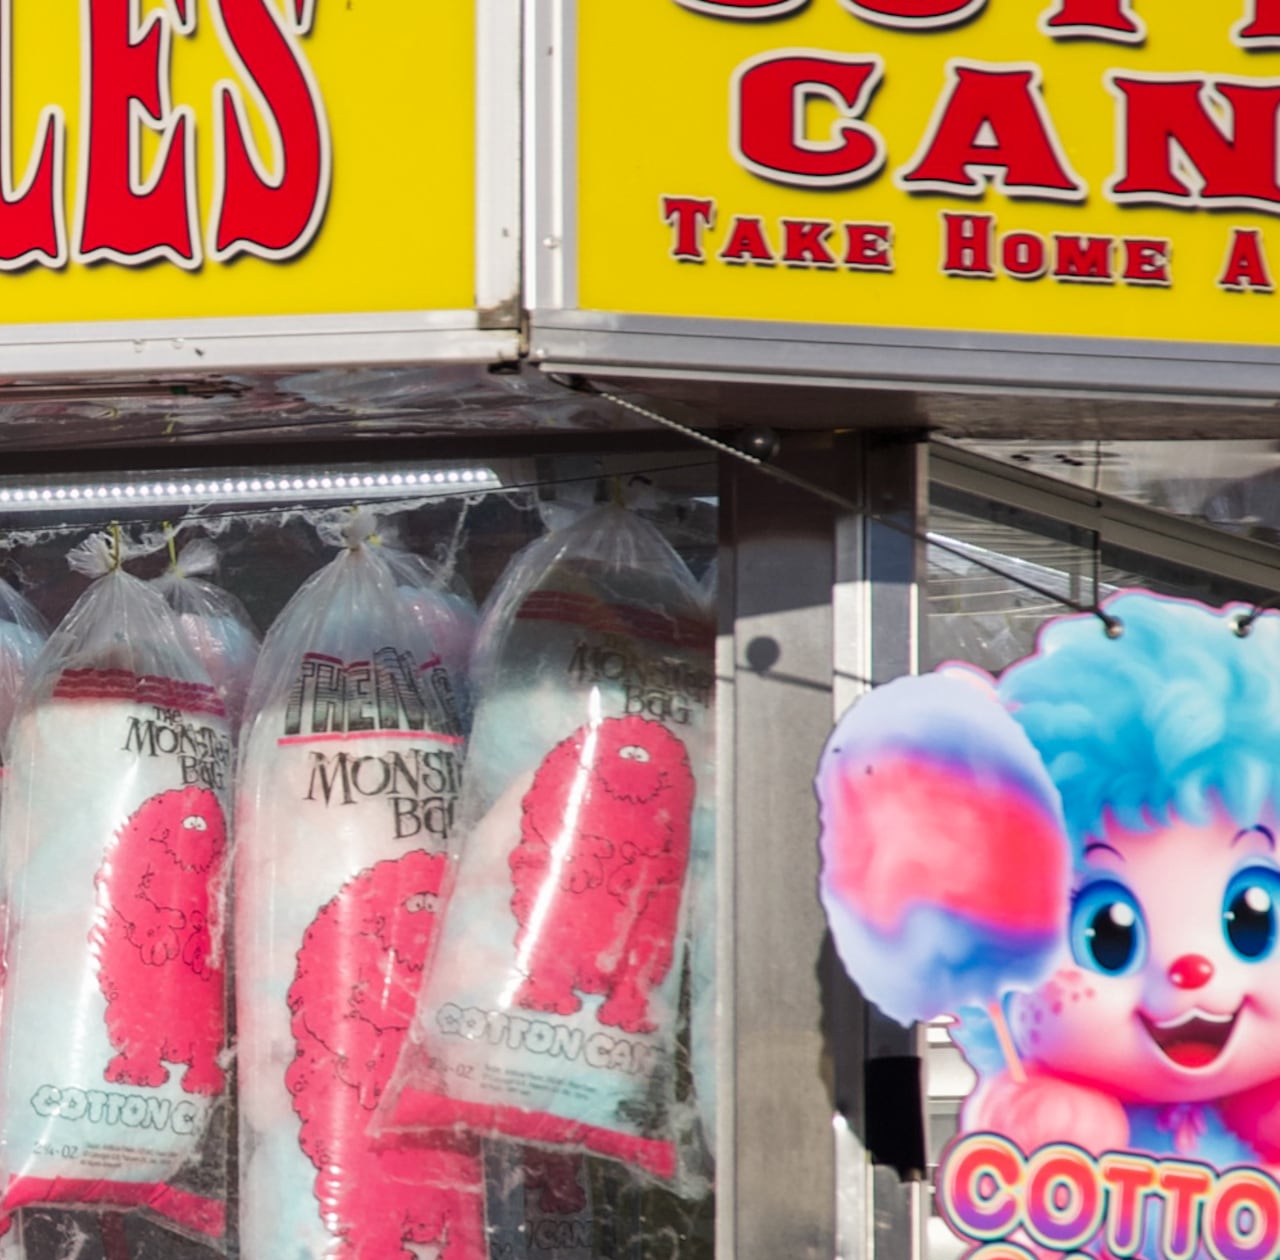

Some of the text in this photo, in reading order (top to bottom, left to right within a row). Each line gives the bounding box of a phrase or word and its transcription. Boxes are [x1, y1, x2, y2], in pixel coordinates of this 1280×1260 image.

[661, 195, 896, 273] TAKE
[941, 210, 1173, 287] HOME
[30, 1084, 171, 1131] COTTON
